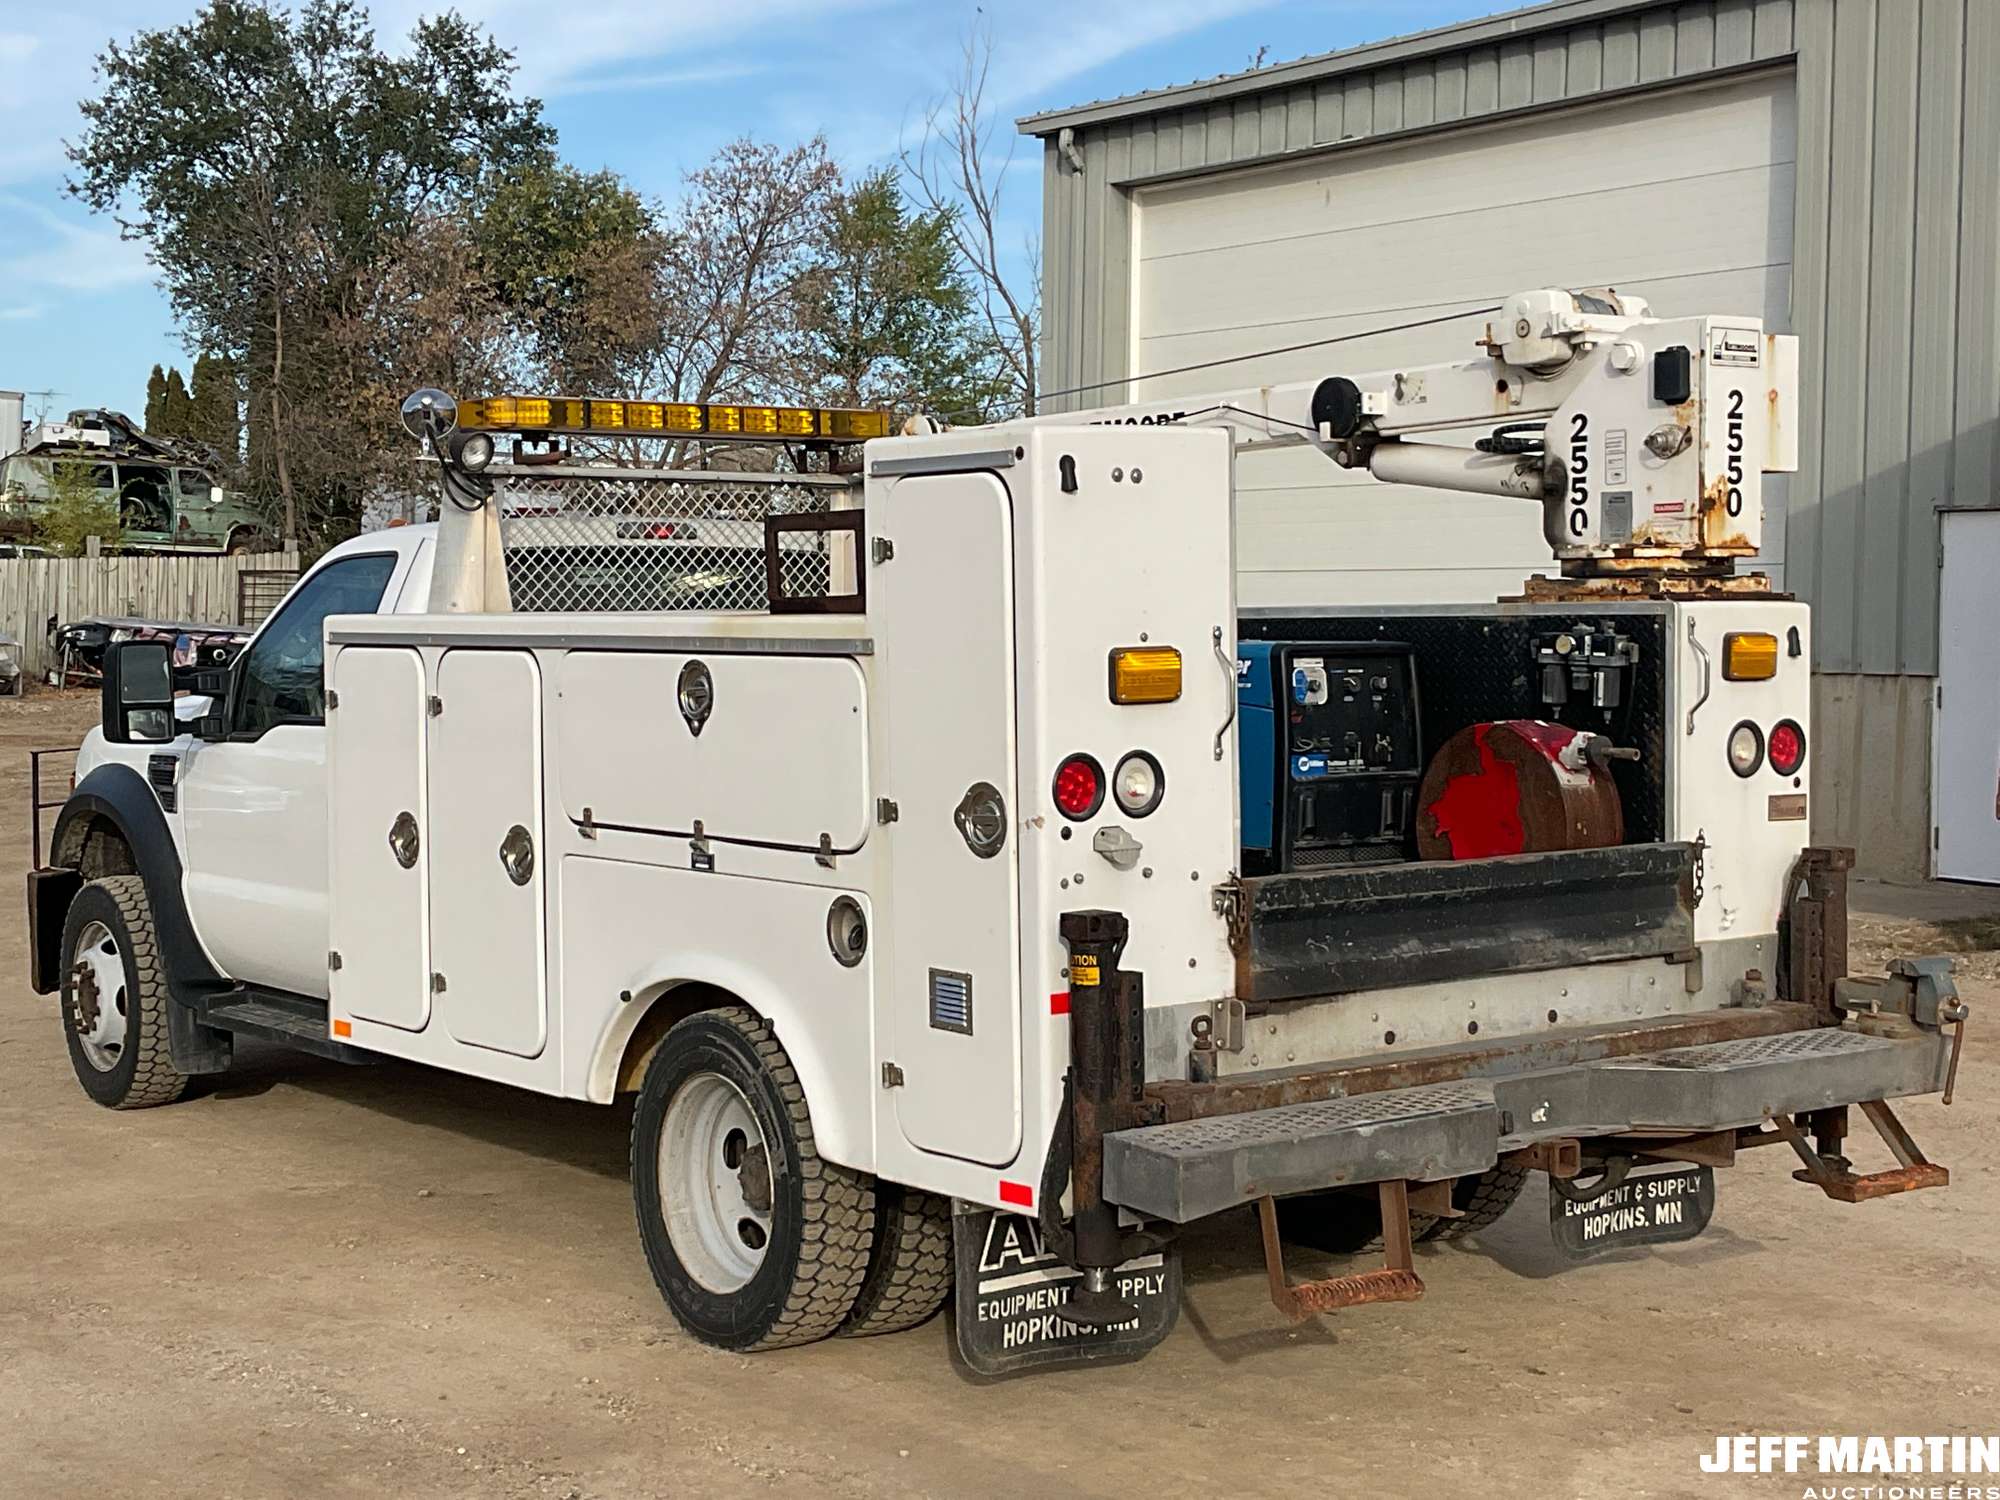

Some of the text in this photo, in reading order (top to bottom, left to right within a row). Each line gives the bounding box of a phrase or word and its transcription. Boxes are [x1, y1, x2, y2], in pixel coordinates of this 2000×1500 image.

[1570, 413, 1588, 537] 2550
[1726, 390, 1744, 517] 2550
[1565, 1175, 1701, 1216] EQUIPMENT & SUPPLY
[1655, 1201, 1682, 1225] MN
[978, 1274, 1165, 1321] EQUIPMENT PPLY
